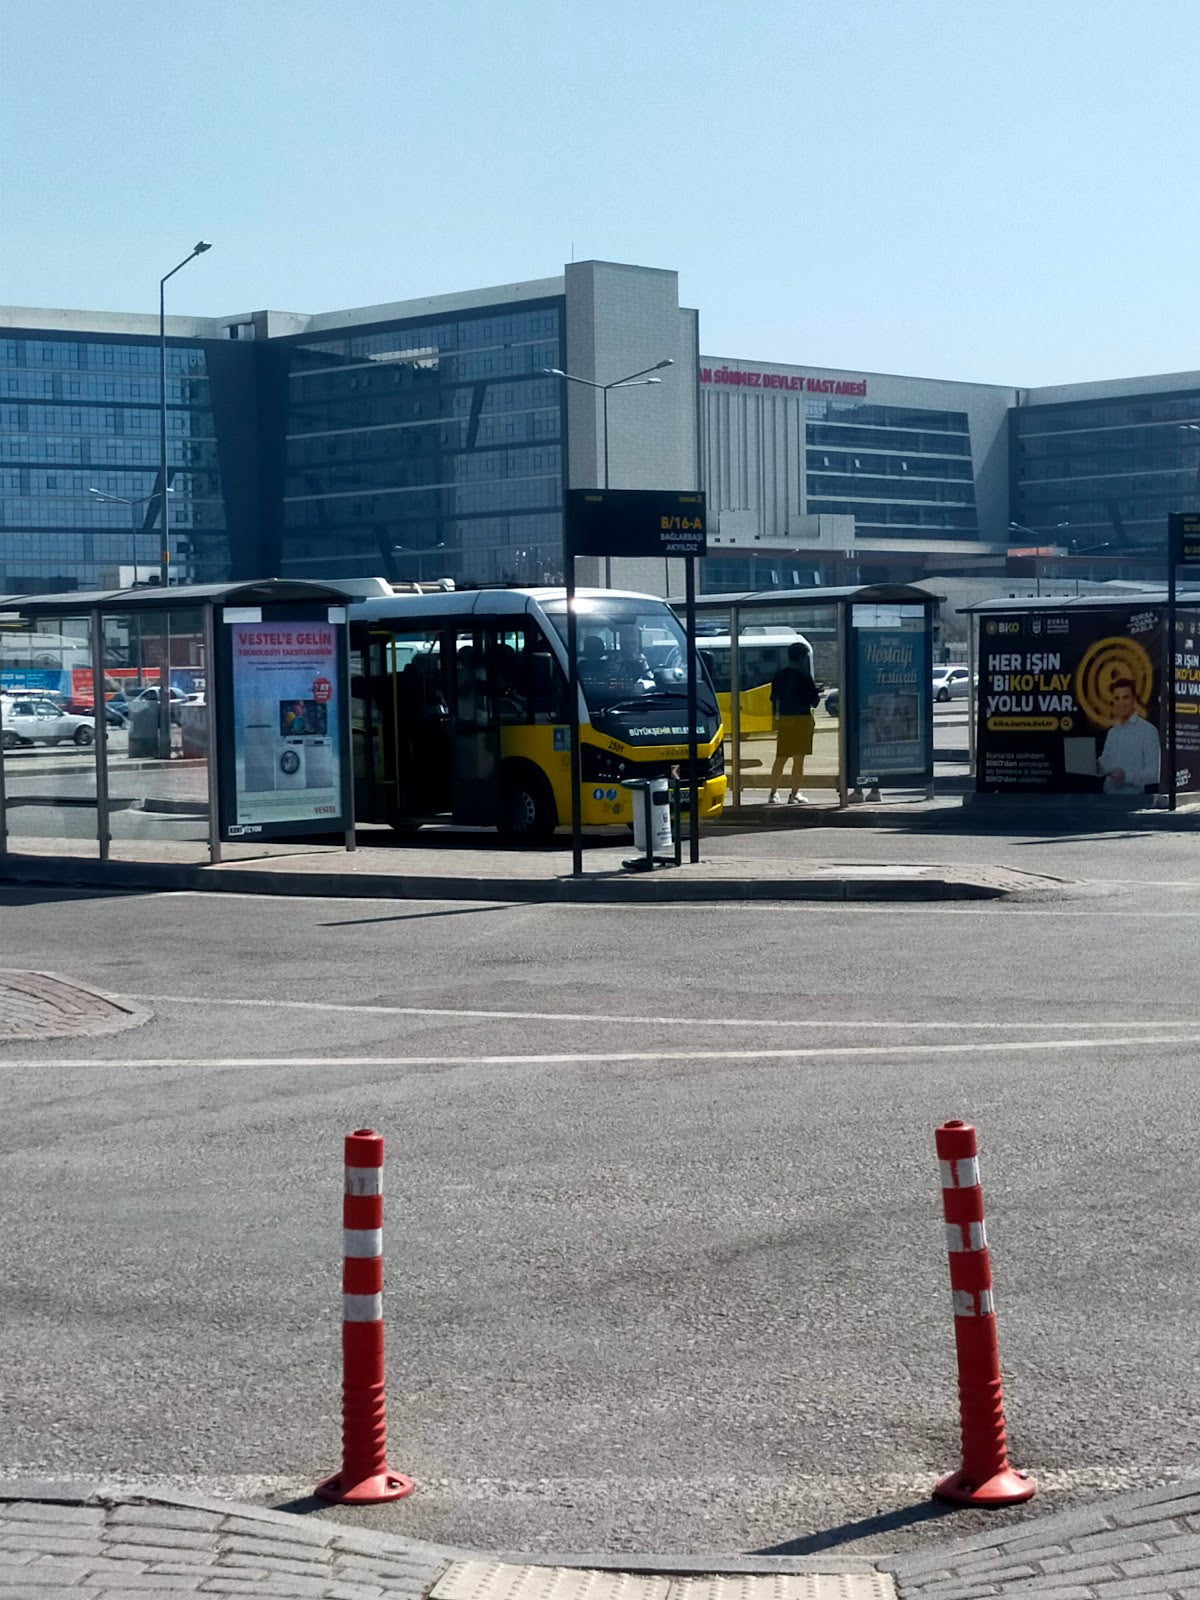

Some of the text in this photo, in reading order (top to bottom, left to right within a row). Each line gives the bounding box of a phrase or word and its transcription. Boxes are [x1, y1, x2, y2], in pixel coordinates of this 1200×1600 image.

[714, 366, 761, 388] SÖNMEZ
[763, 373, 805, 391] DEVLET
[807, 378, 867, 397] HASTANESİ
[660, 516, 702, 530] B/16-A
[666, 543, 698, 551] AKYILDIZ
[239, 629, 331, 645] VESTEL'E GELİN
[988, 654, 1022, 671] HER
[987, 695, 1078, 712] YOLU VAR.
[628, 726, 671, 737] BÜYÜKŞEHİR
